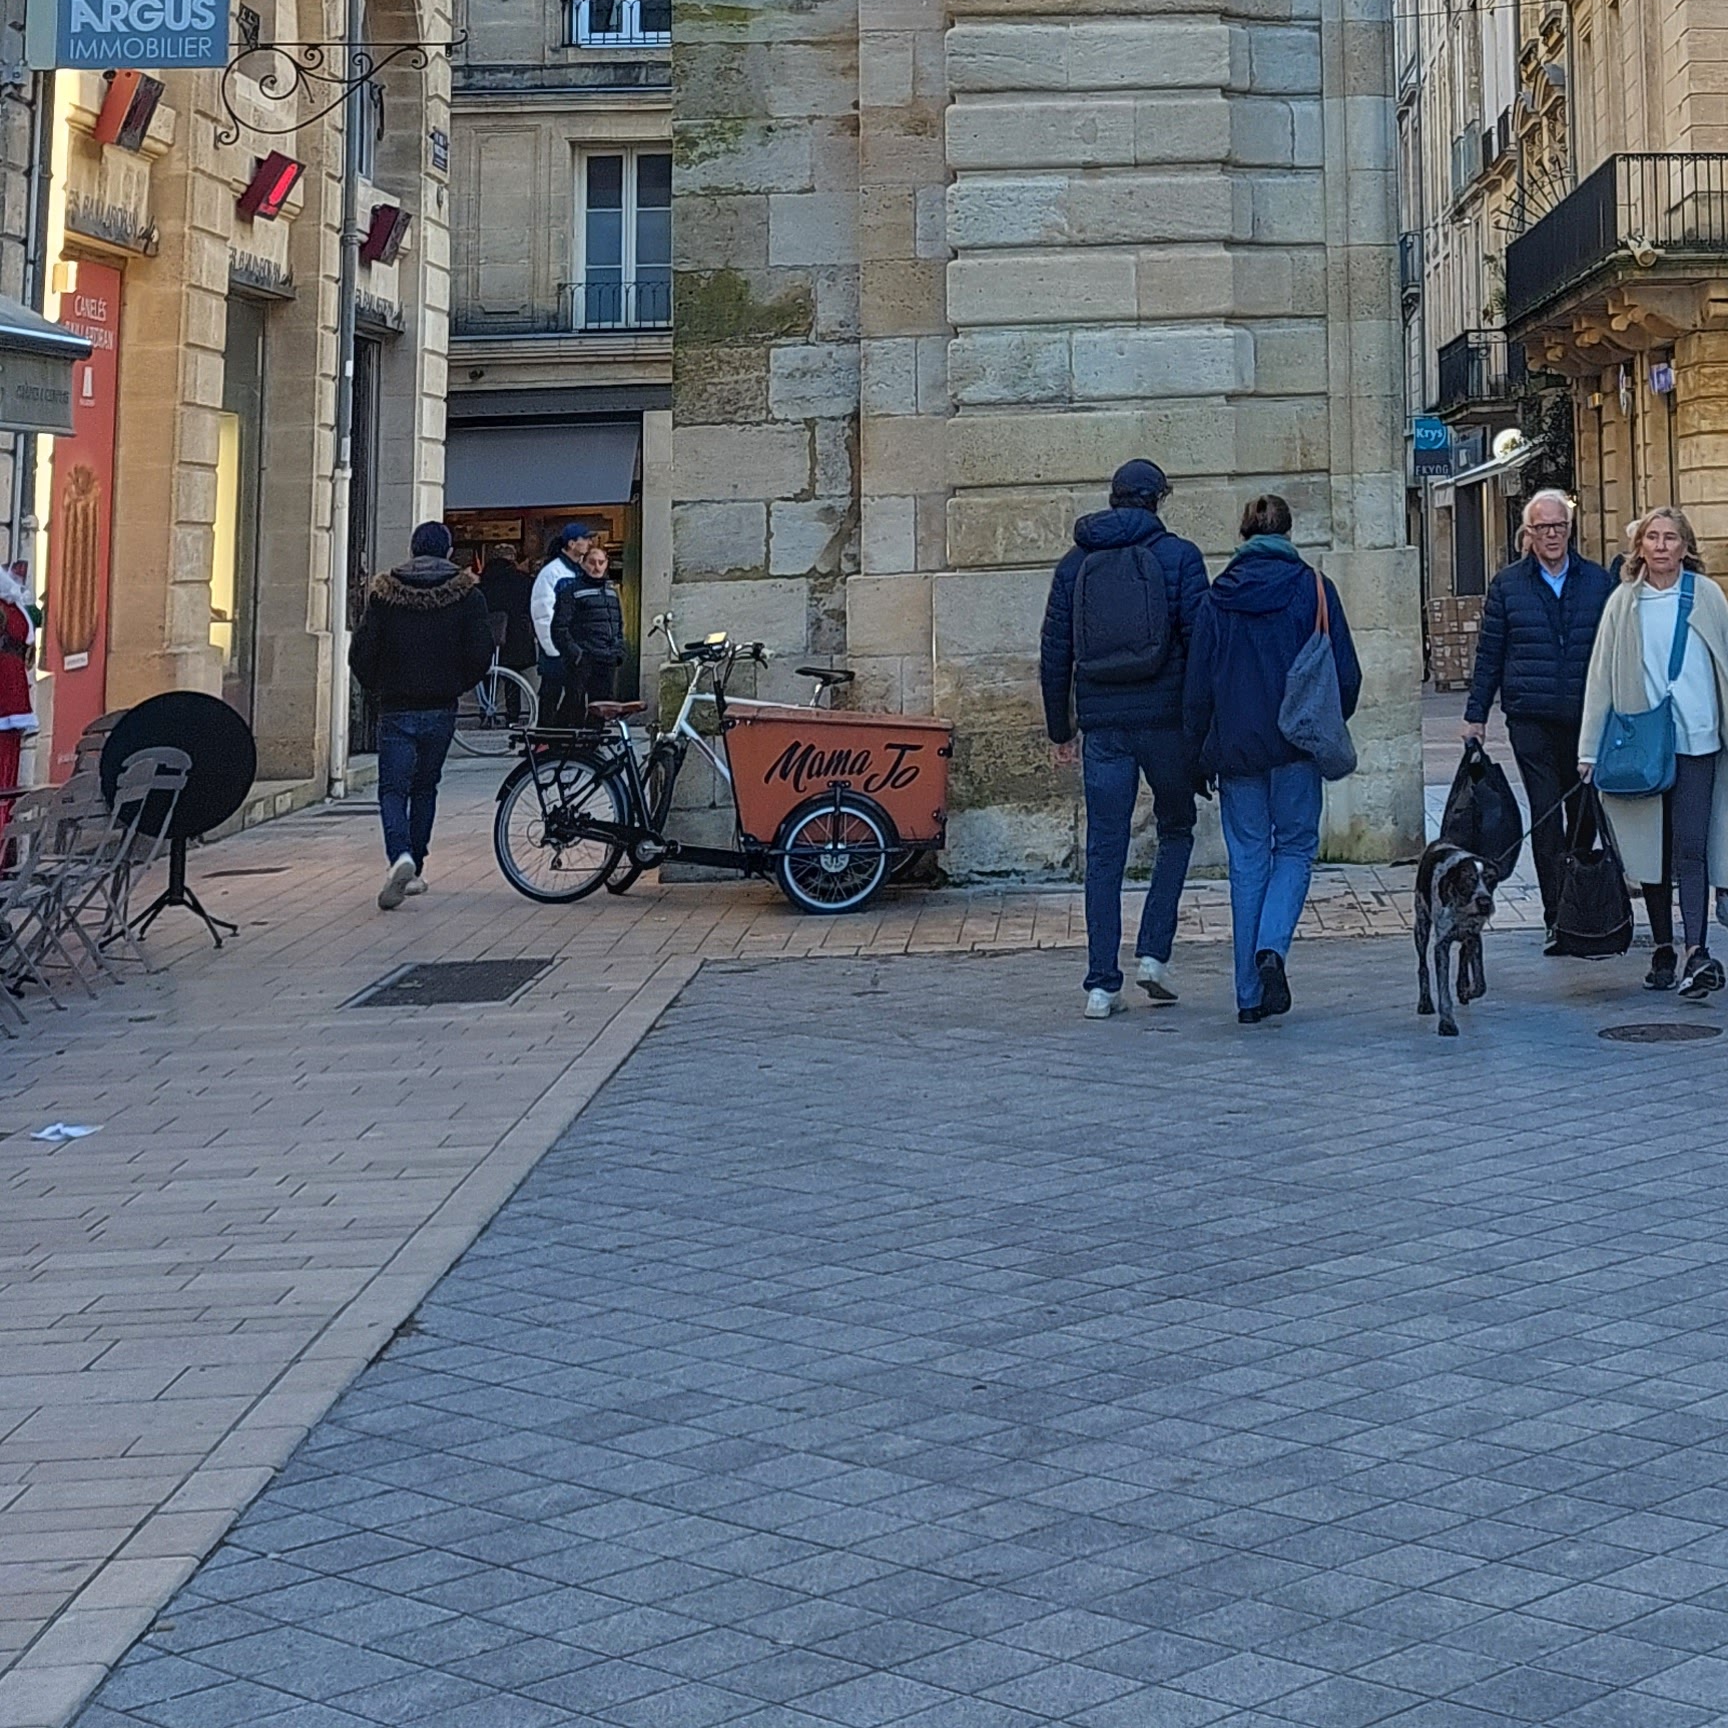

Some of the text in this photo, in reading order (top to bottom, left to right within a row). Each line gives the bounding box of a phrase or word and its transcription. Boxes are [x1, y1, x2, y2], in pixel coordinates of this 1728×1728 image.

[69, 36, 213, 60] IMMOBILIER
[1416, 427, 1443, 441] Krys
[763, 740, 924, 793] Mama Jo
